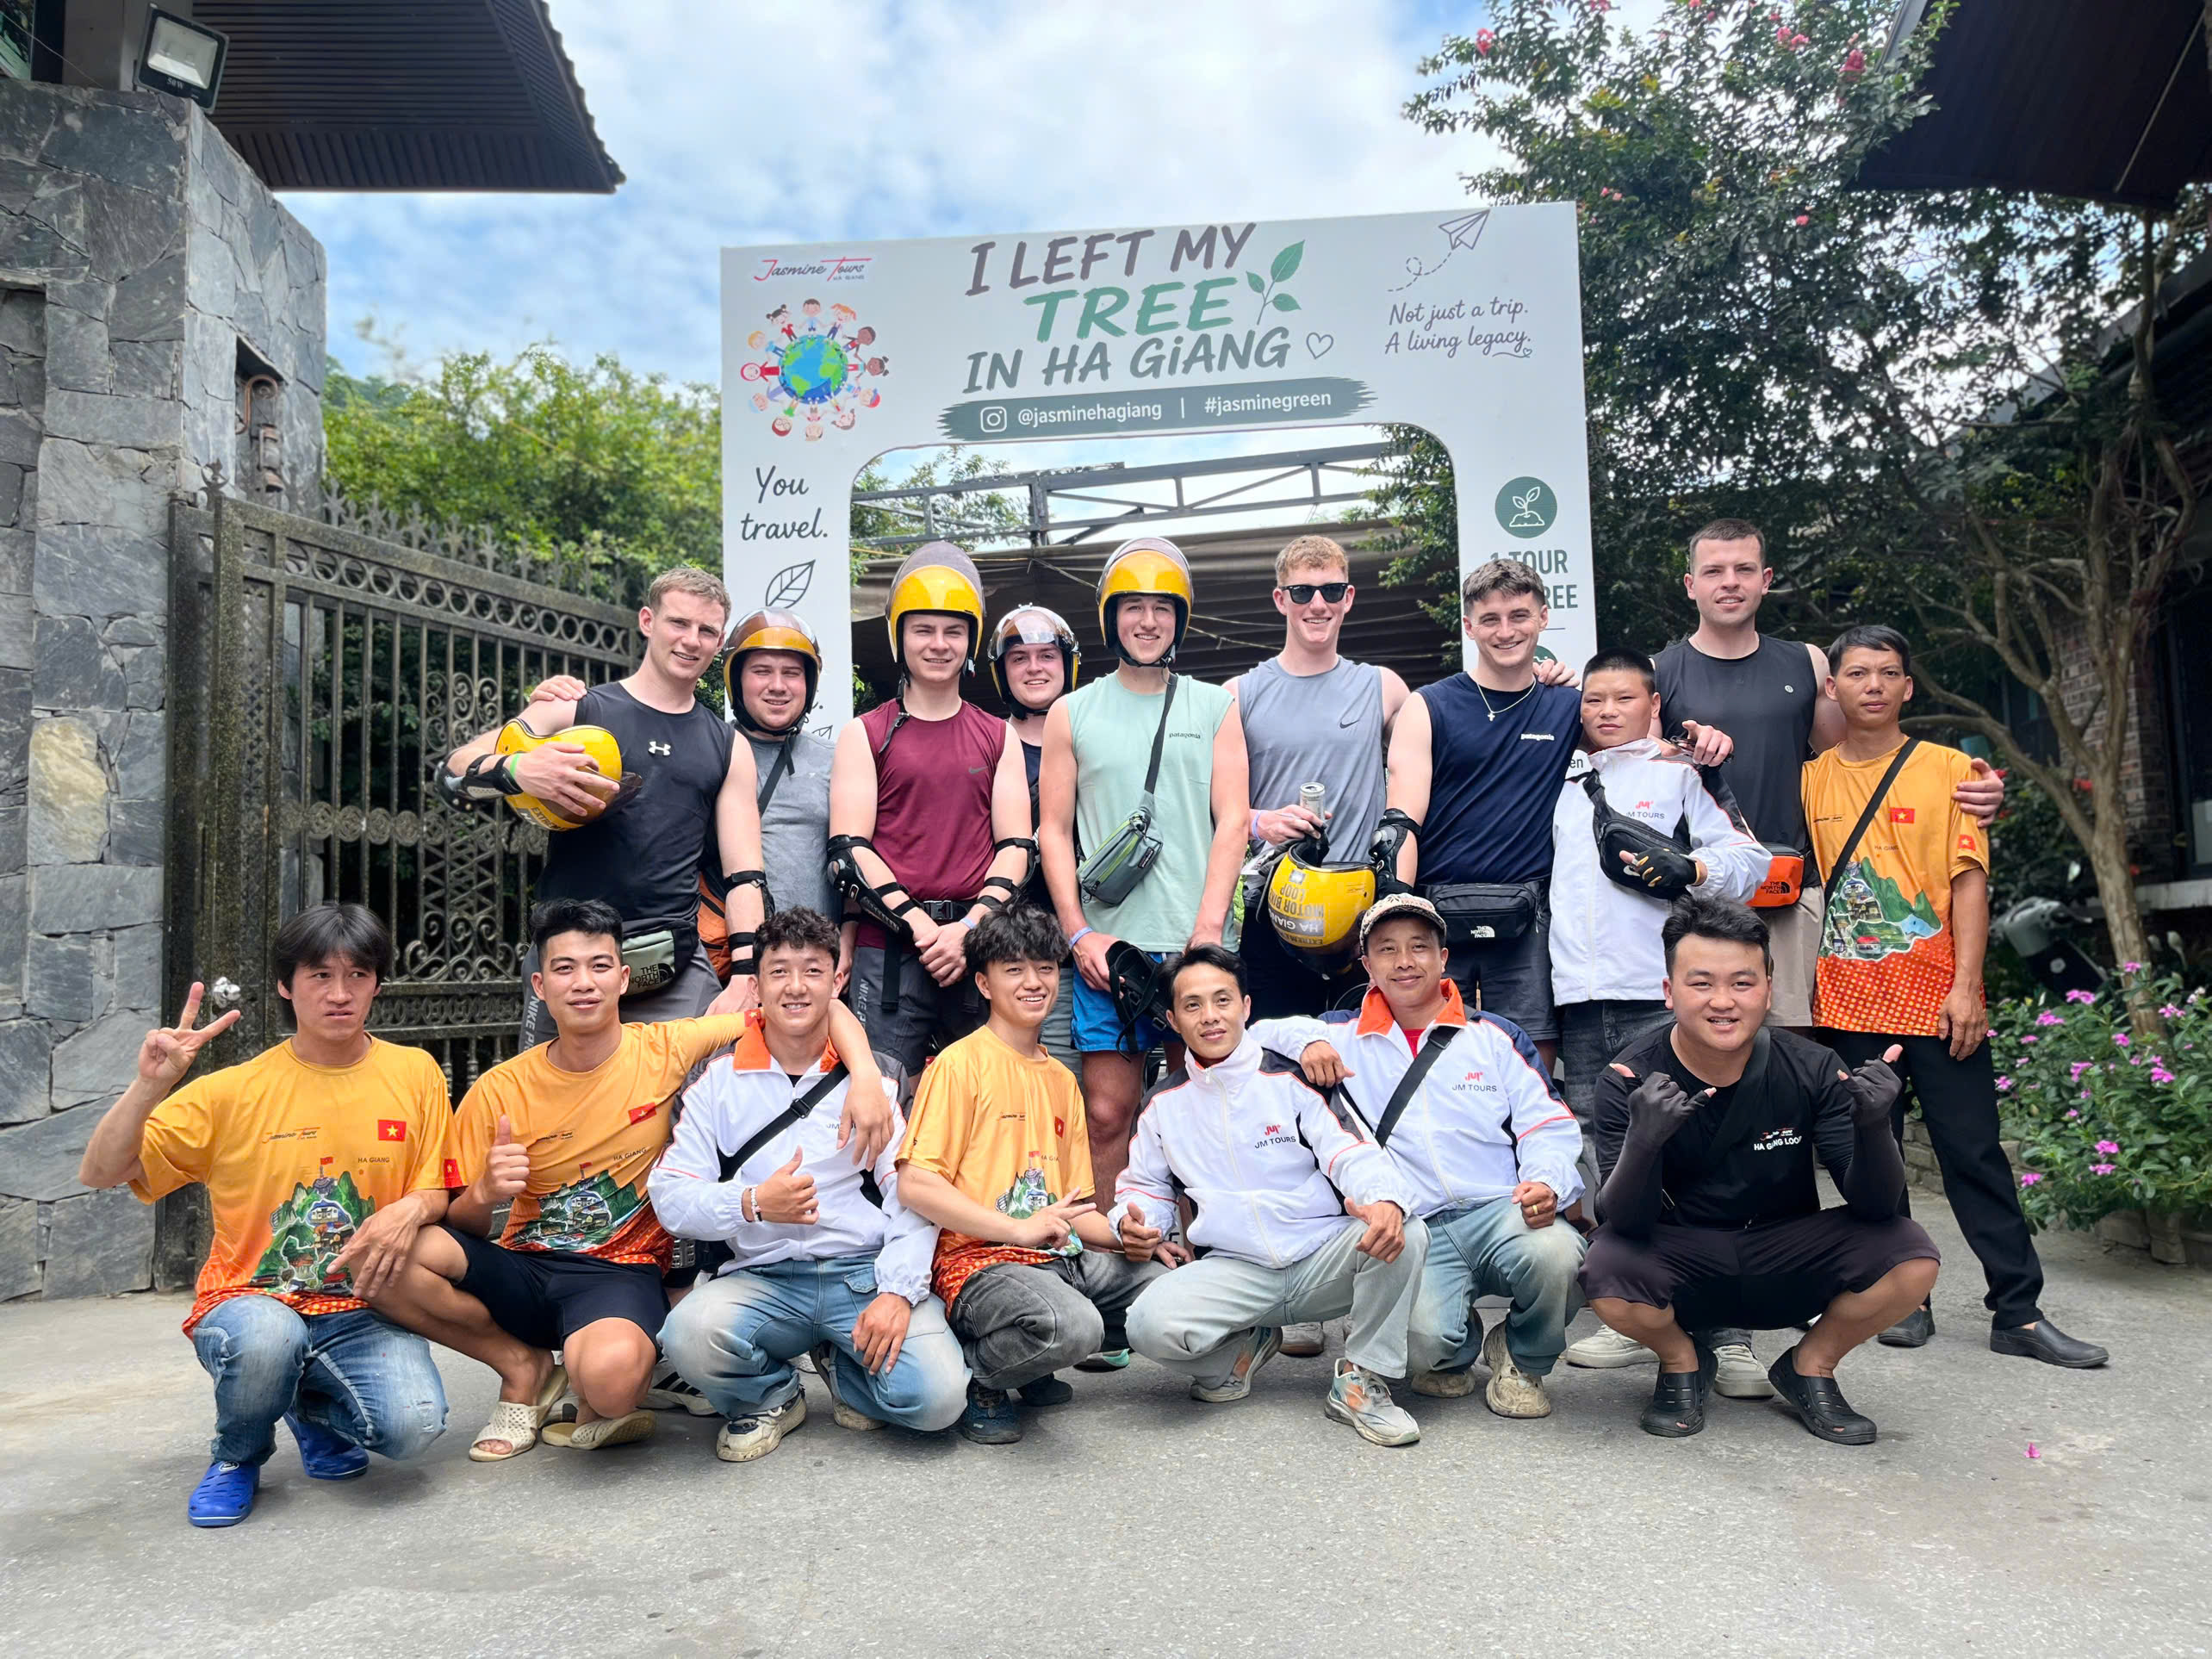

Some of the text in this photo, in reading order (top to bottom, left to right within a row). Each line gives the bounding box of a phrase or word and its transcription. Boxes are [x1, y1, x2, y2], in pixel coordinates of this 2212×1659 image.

[754, 257, 873, 282] Jasmine Tours
[965, 222, 1257, 296] I LEFT MY
[1023, 276, 1239, 343] TREE
[1389, 296, 1529, 331] Not just a trip.
[1384, 326, 1532, 358] A living legacy.
[962, 348, 1023, 394] IN
[1042, 341, 1111, 386] HA
[1017, 390, 1332, 426] @jasminehagiang #jasminegreen
[755, 465, 809, 504] You
[740, 507, 829, 541] travel.
[1544, 584, 1578, 609] REE
[1299, 923, 1319, 933] HA
[638, 979, 660, 988] FACE
[641, 964, 658, 974] THE
[858, 979, 868, 1010] NIKE
[525, 996, 540, 1030] NIKE
[624, 1146, 648, 1159] GIANG
[1255, 1140, 1268, 1149] JM
